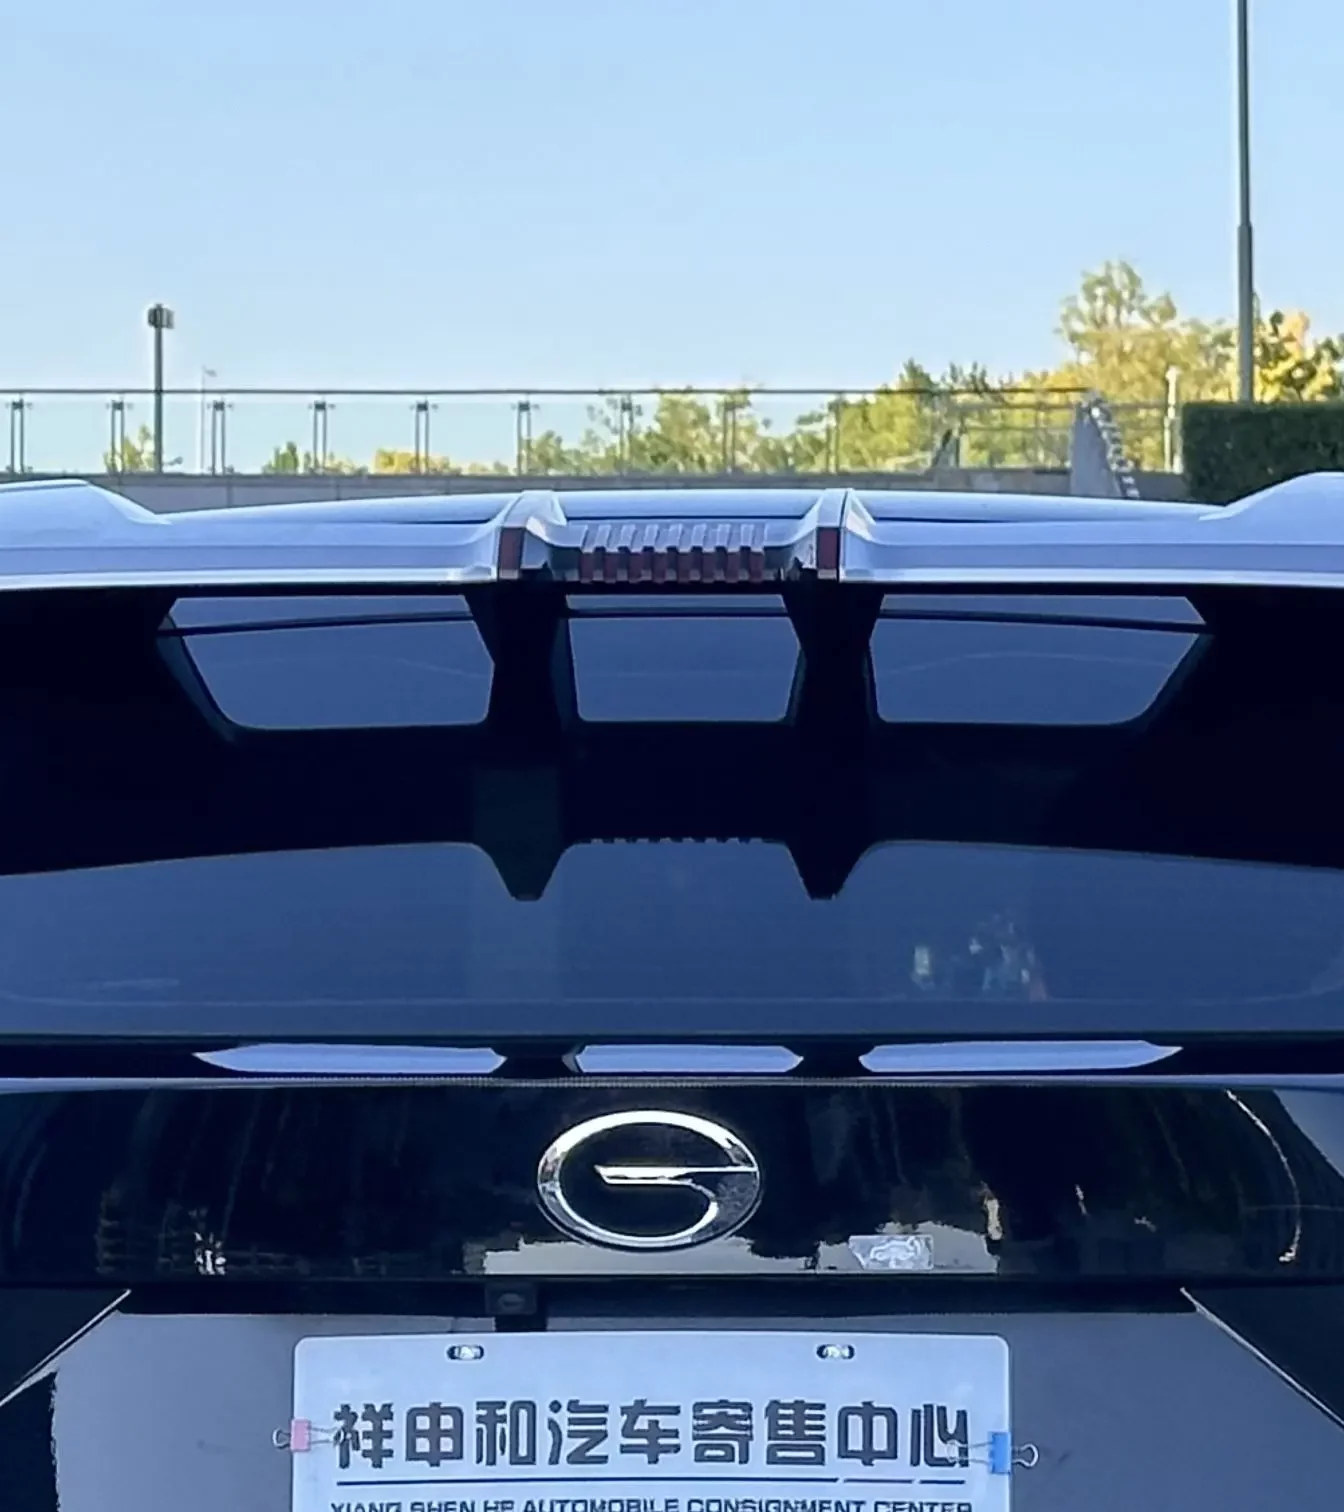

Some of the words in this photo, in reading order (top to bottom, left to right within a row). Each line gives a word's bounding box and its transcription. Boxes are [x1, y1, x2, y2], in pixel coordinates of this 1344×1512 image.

[333, 1399, 970, 1469] 祥申和汽车寄售中心
